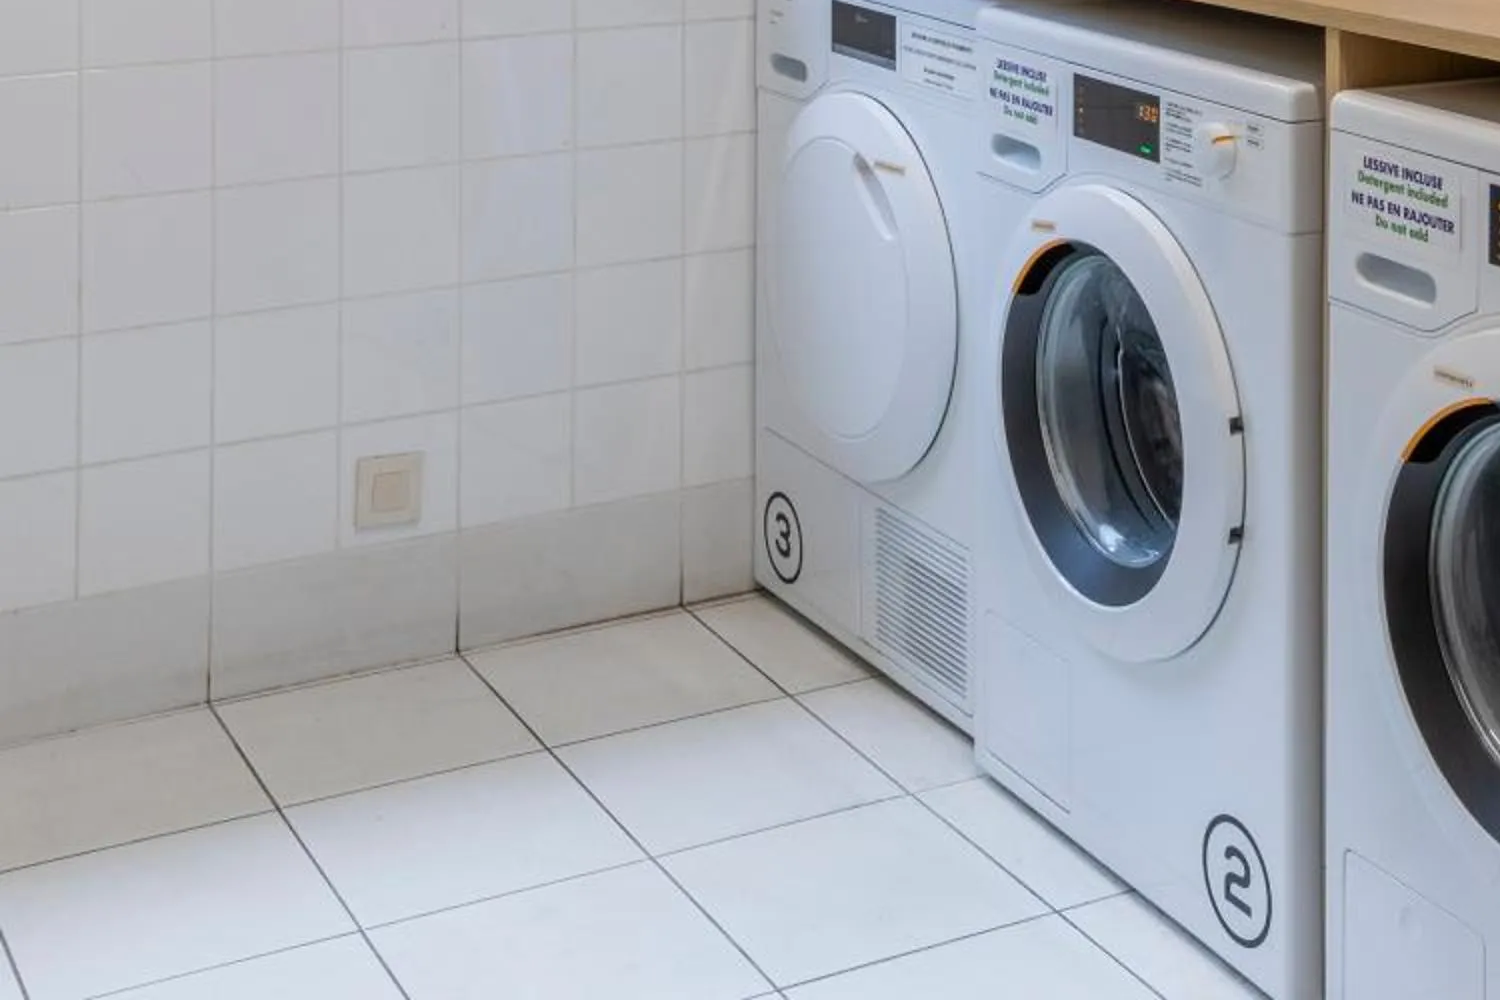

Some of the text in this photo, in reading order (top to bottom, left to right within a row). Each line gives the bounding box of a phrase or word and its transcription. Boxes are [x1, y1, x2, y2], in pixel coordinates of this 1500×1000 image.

[1358, 169, 1448, 208] Detergent included
[1363, 155, 1443, 191] LESSIVE INCLUSE
[1351, 190, 1455, 234] NE PAS EN RAJOUTER
[1375, 214, 1389, 229] Do
[1391, 222, 1407, 236] not
[776, 512, 792, 559] 3
[1223, 844, 1253, 918] 2
